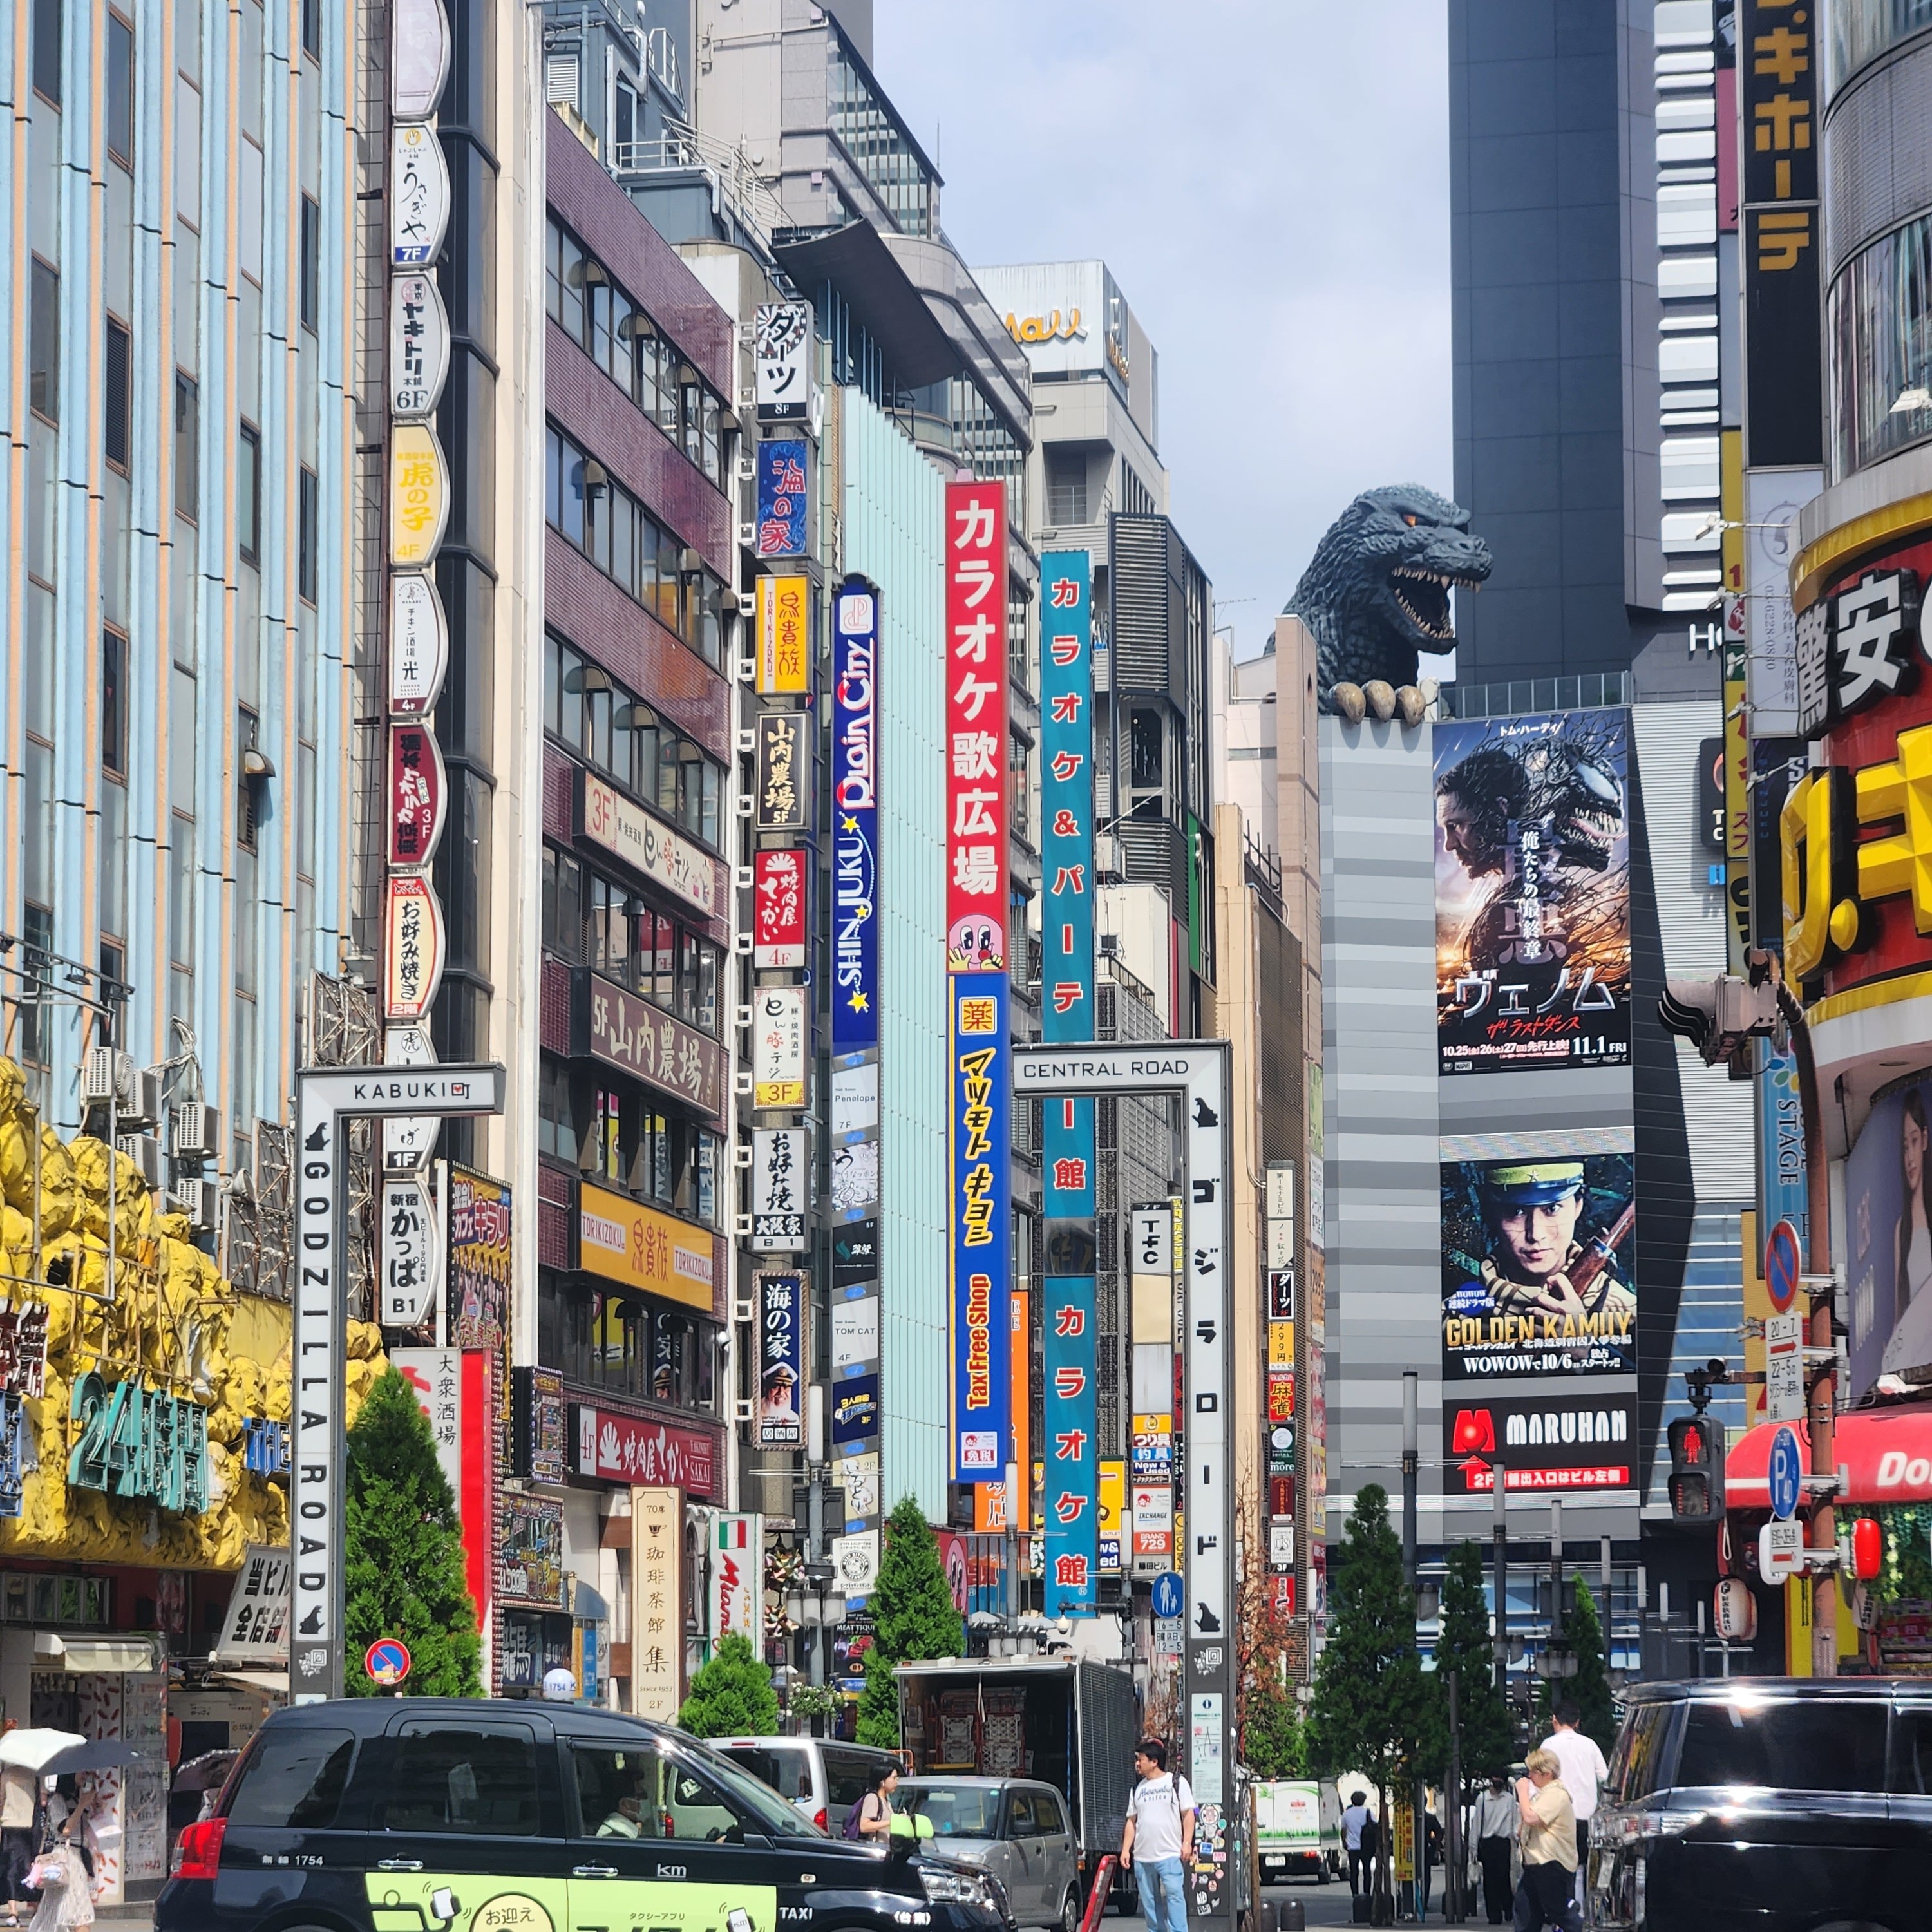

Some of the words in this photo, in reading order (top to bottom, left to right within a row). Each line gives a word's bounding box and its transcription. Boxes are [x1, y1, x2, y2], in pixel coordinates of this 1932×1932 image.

[399, 162, 428, 242] うさぎや
[402, 247, 421, 260] 7F
[414, 283, 423, 301] 東京
[402, 302, 424, 375] ヤキトリ
[766, 310, 799, 394] ダーツ
[397, 390, 428, 410] 6F
[775, 404, 790, 414] 8F
[399, 462, 435, 531] 虎の子
[759, 459, 806, 553] 海の家
[396, 544, 420, 557] 4F
[779, 591, 800, 676] 鳥貴族
[402, 661, 418, 681] 光
[1795, 573, 1932, 738] 驚安
[402, 700, 415, 710] 4F
[953, 500, 998, 896] カラオケ歌広場
[764, 718, 796, 809] 山内農場
[593, 790, 611, 835] 3F
[773, 810, 789, 823] 5F
[779, 871, 801, 927] 焼肉屋
[1050, 578, 1086, 1190] カラオケ&パーテー館
[1521, 831, 1542, 959] 俺たちの最終章
[838, 837, 872, 987] SHINJUKU
[401, 900, 421, 1000] お好み焼き
[769, 948, 791, 965] 4F
[391, 1003, 419, 1015] 2階
[1455, 967, 1615, 1018] ヴェノム
[594, 996, 607, 1037] 5F
[963, 1001, 993, 1030] 薬
[610, 996, 703, 1101] 山内農場
[1572, 1036, 1605, 1055] 11.1
[1609, 1043, 1627, 1052] FRI
[1024, 1063, 1122, 1077] CENTRAL
[1132, 1060, 1188, 1075] ROAD
[768, 1084, 794, 1102] 3F
[960, 1048, 996, 1246] マツモトキヨシ
[1778, 1098, 1799, 1185] STAGE
[394, 1153, 415, 1167] 1F
[766, 1132, 795, 1211] お好み焼
[390, 1193, 418, 1206] 新宿
[455, 1212, 473, 1240] カフェ
[475, 1193, 509, 1253] キラリ
[582, 1215, 623, 1249] TORIKIZOKU
[756, 1216, 802, 1235] 大阪家
[390, 1208, 419, 1288] かっぱ
[632, 1218, 668, 1282] 鳥貴族
[1142, 1220, 1160, 1264] TFC
[674, 1248, 712, 1282] TORIKIZOKU
[301, 1162, 331, 1430] GODZILLA
[393, 1298, 415, 1313] B1
[968, 1274, 990, 1327] Shop
[1279, 1274, 1290, 1308] ダーツ
[1448, 1297, 1495, 1309] 連続ドラマ版
[766, 1283, 793, 1358] 海の家
[1446, 1315, 1535, 1347] GOLDEN
[1544, 1311, 1632, 1339] KAMUY
[968, 1327, 989, 1376] Free
[1193, 1178, 1220, 1555] ゴジラロード
[436, 1354, 458, 1446] 大衆酒場
[968, 1375, 989, 1410] Tax
[1271, 1381, 1293, 1414] 麻雀
[581, 1419, 596, 1461] 4F
[1134, 1434, 1170, 1446] つり具
[1506, 1410, 1627, 1445] MARUHAN
[1055, 1305, 1088, 1587] カラオケ館
[690, 1462, 710, 1482] SAKAI
[864, 1461, 875, 1470] 2F
[1775, 1450, 1787, 1505] P
[1878, 1451, 1932, 1487] Do
[647, 1505, 665, 1513] 70席
[299, 1465, 327, 1591] ROAD
[1141, 1540, 1166, 1549] 729
[647, 1546, 665, 1634] 珈琲茶館
[643, 1645, 670, 1674] 集
[649, 1701, 663, 1709] 2F
[295, 1855, 323, 1866] 1754
[656, 1864, 687, 1877] km
[485, 1908, 535, 1925] お迎え
[630, 1912, 685, 1921] タクシーアプリ
[780, 1907, 813, 1920] TAXI
